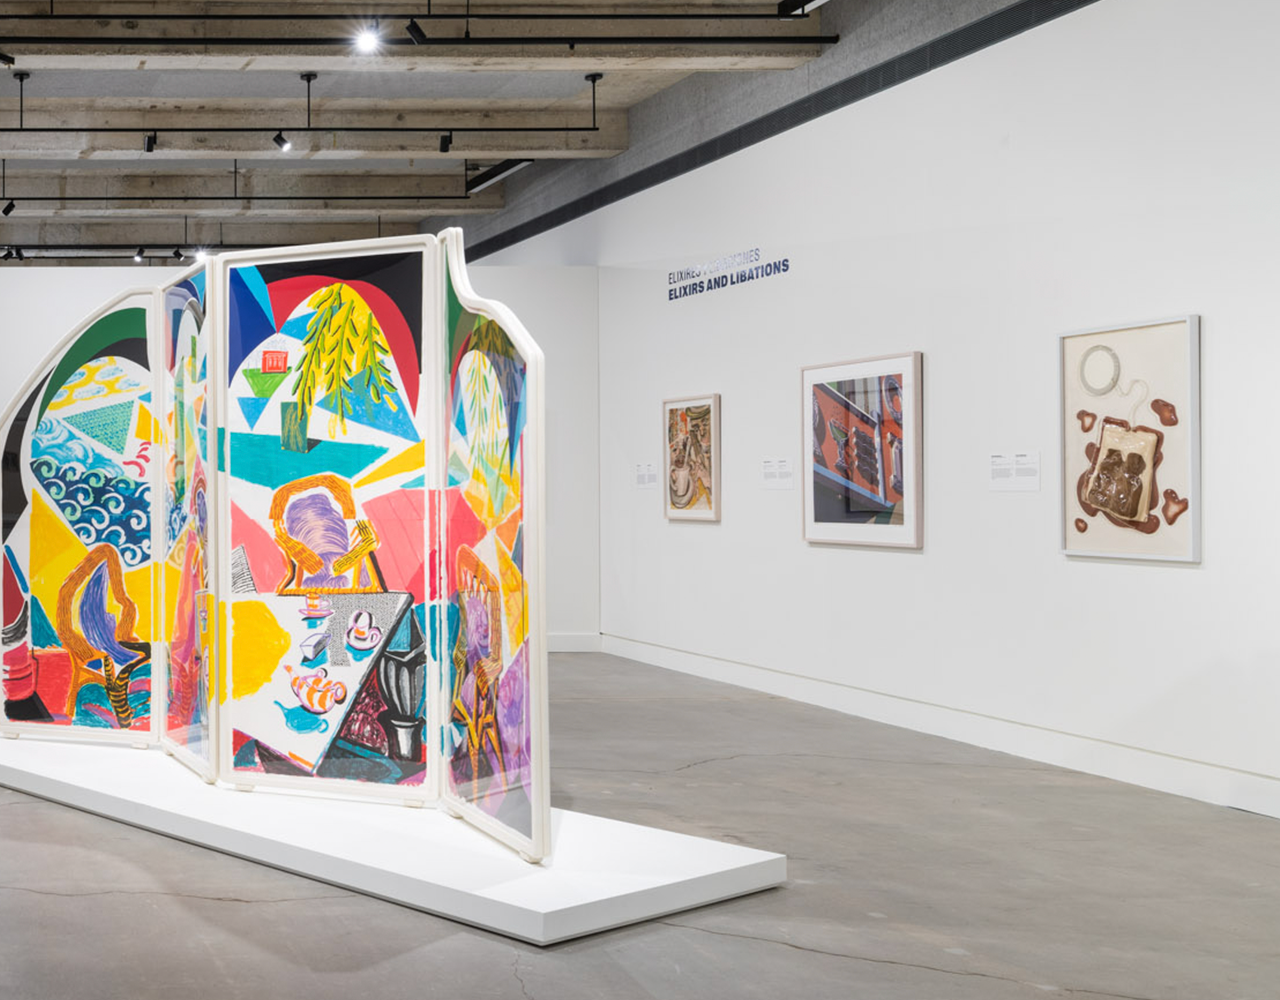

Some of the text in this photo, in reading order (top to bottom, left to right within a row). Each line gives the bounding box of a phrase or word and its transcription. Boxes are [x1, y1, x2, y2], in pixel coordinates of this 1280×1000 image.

[668, 258, 790, 301] ELIXIRS AND LIBATIONS
